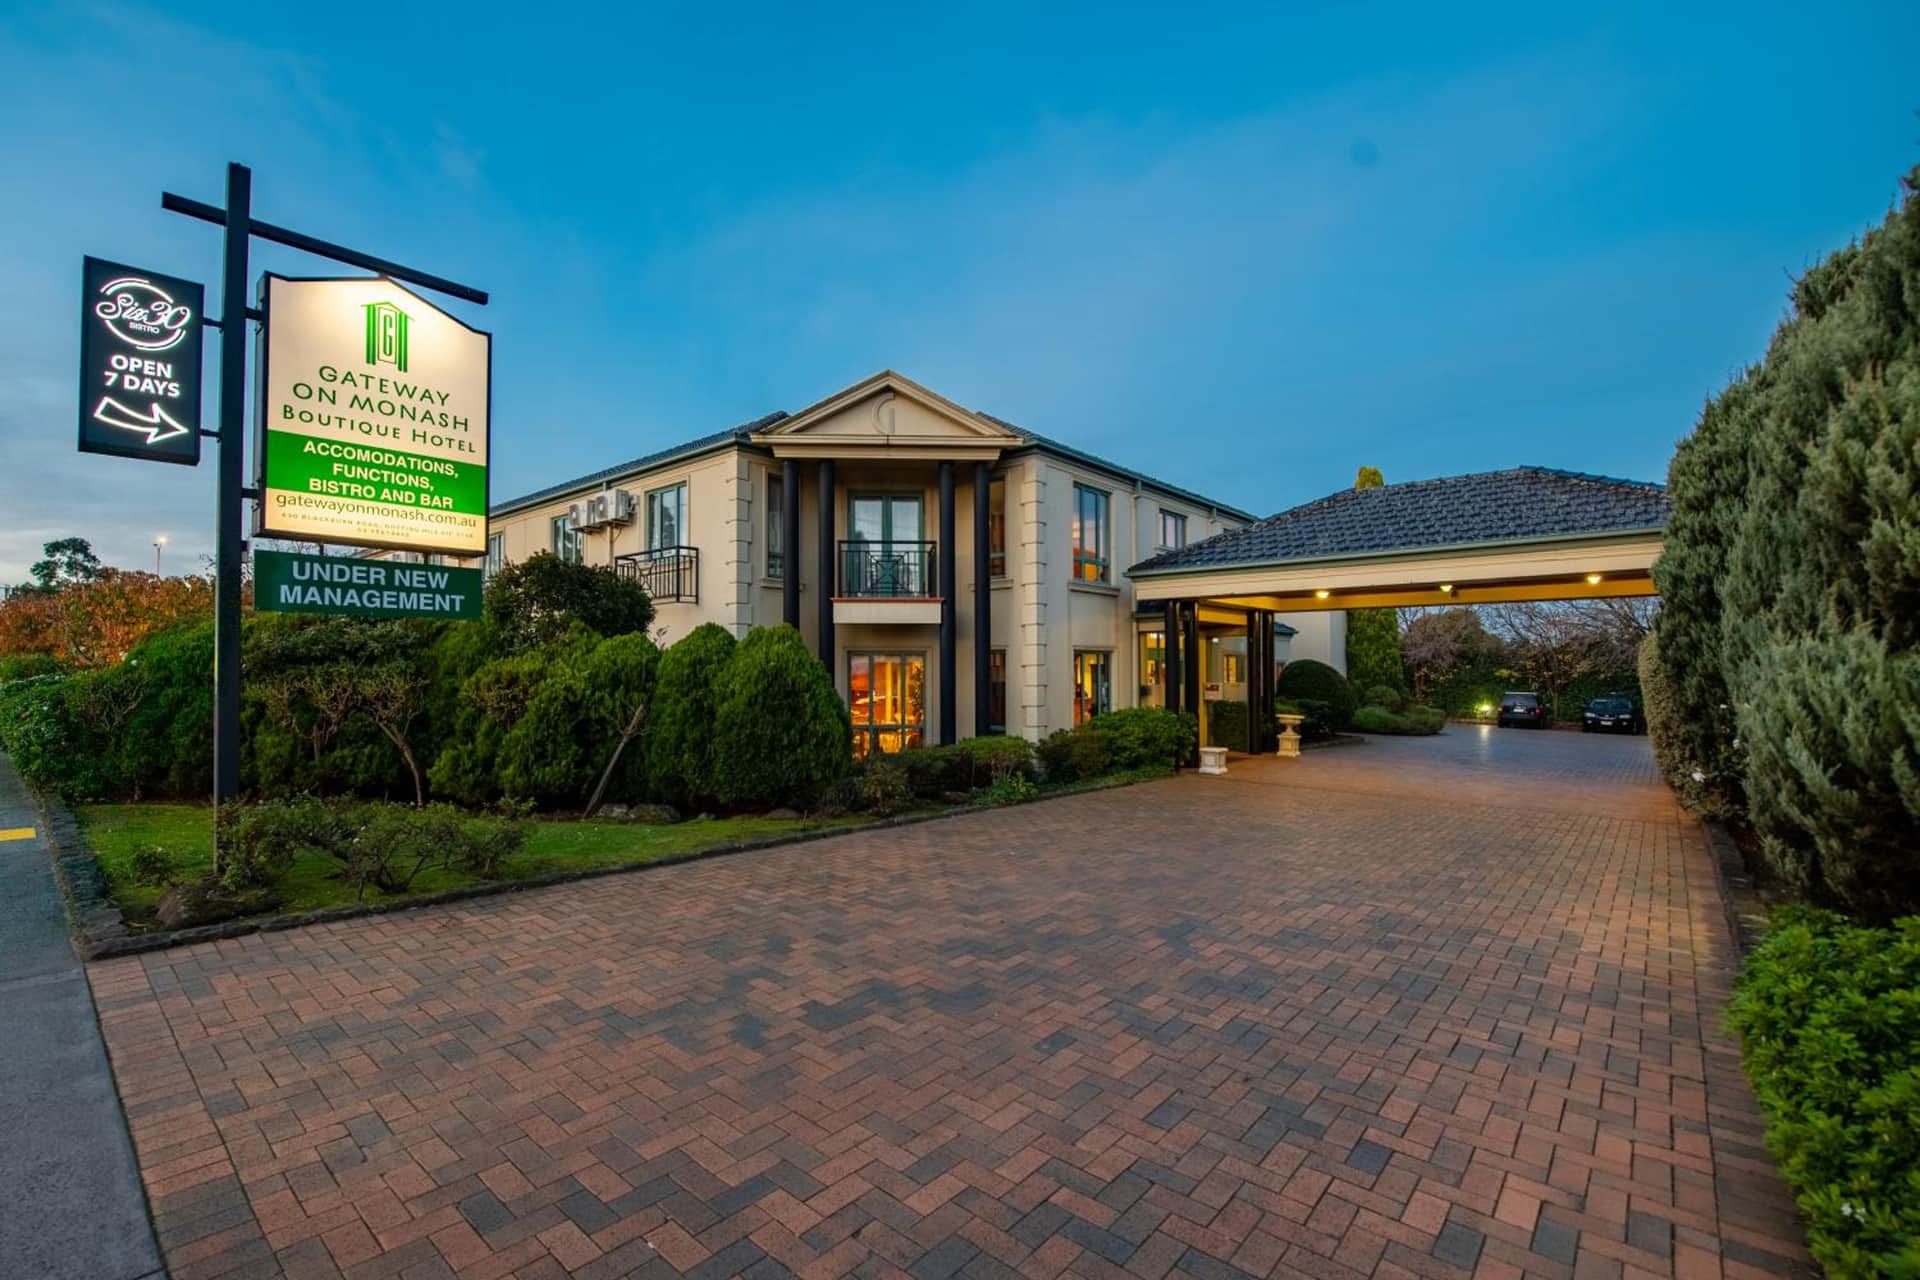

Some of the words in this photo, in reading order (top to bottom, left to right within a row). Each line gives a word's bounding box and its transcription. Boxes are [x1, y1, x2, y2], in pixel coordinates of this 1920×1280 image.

[110, 354, 173, 379] OPEN
[104, 371, 119, 387] 7
[123, 376, 181, 398] DAYS
[319, 365, 450, 407] GATEWAY
[292, 382, 337, 405] ON
[349, 394, 469, 432] MONASH
[282, 404, 401, 440] BOUTIQUE
[412, 428, 476, 453] HOTEL
[303, 440, 459, 479] ACCOMODATIONS,
[332, 462, 435, 492] FUNCTIONS,
[308, 478, 376, 500] BISTRO
[379, 488, 416, 504] AND
[419, 494, 454, 509] BAR
[275, 493, 477, 528] gatewayonmonash.com.au
[292, 560, 387, 586] UNDER
[393, 569, 449, 590] NEW
[279, 584, 466, 612] MANAGEMENT
